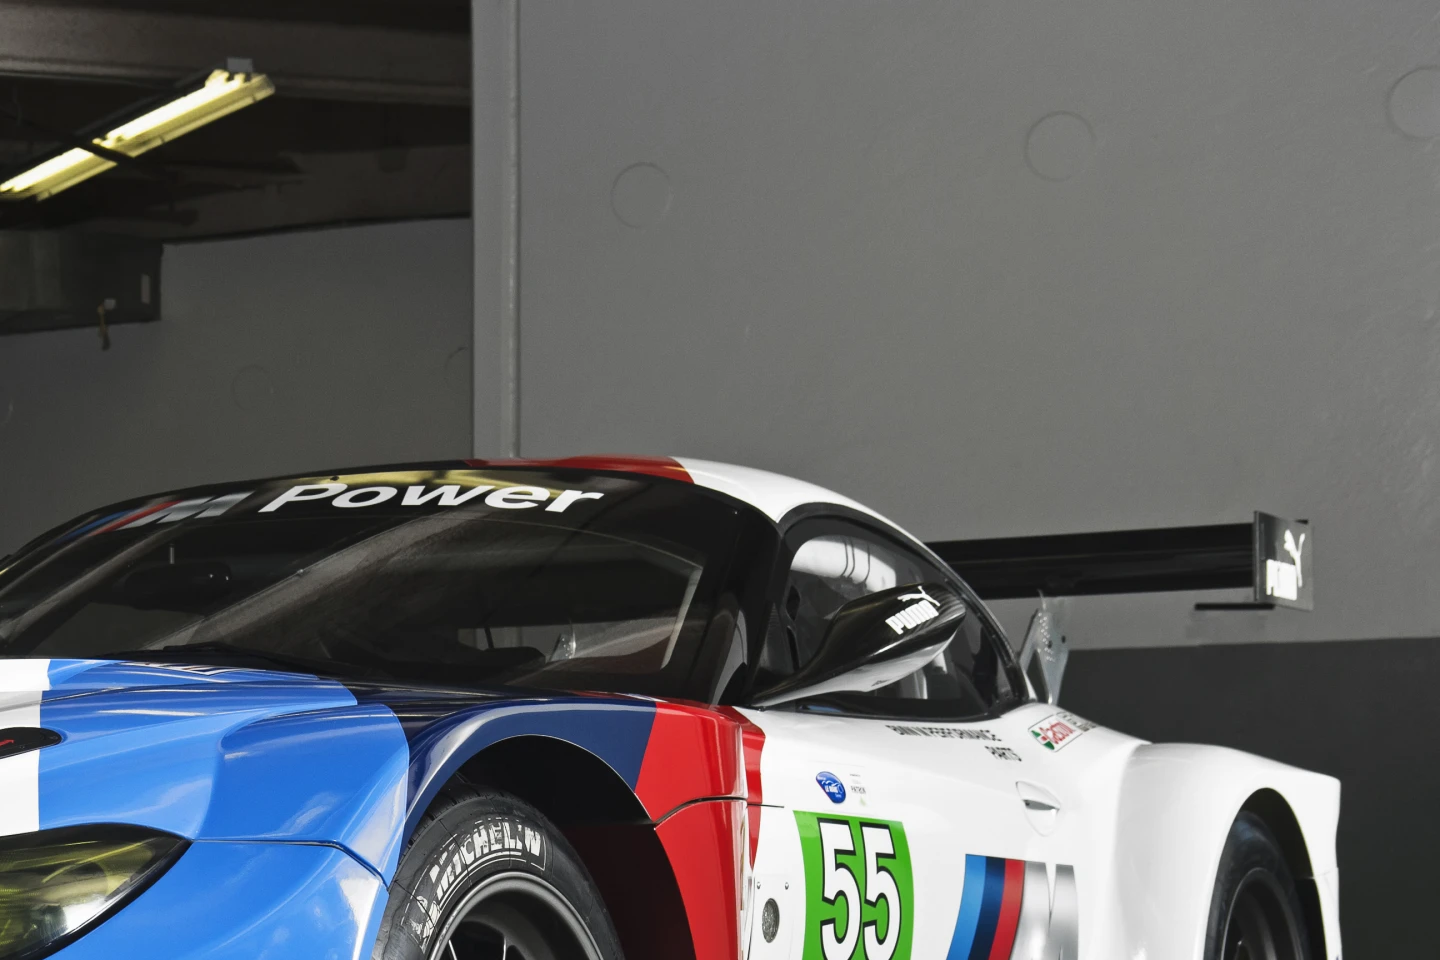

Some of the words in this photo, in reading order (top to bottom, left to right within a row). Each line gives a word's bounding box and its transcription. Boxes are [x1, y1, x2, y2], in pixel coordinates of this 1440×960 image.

[257, 483, 605, 513] Power
[885, 599, 940, 635] PUMA
[984, 745, 1022, 762] PARTS
